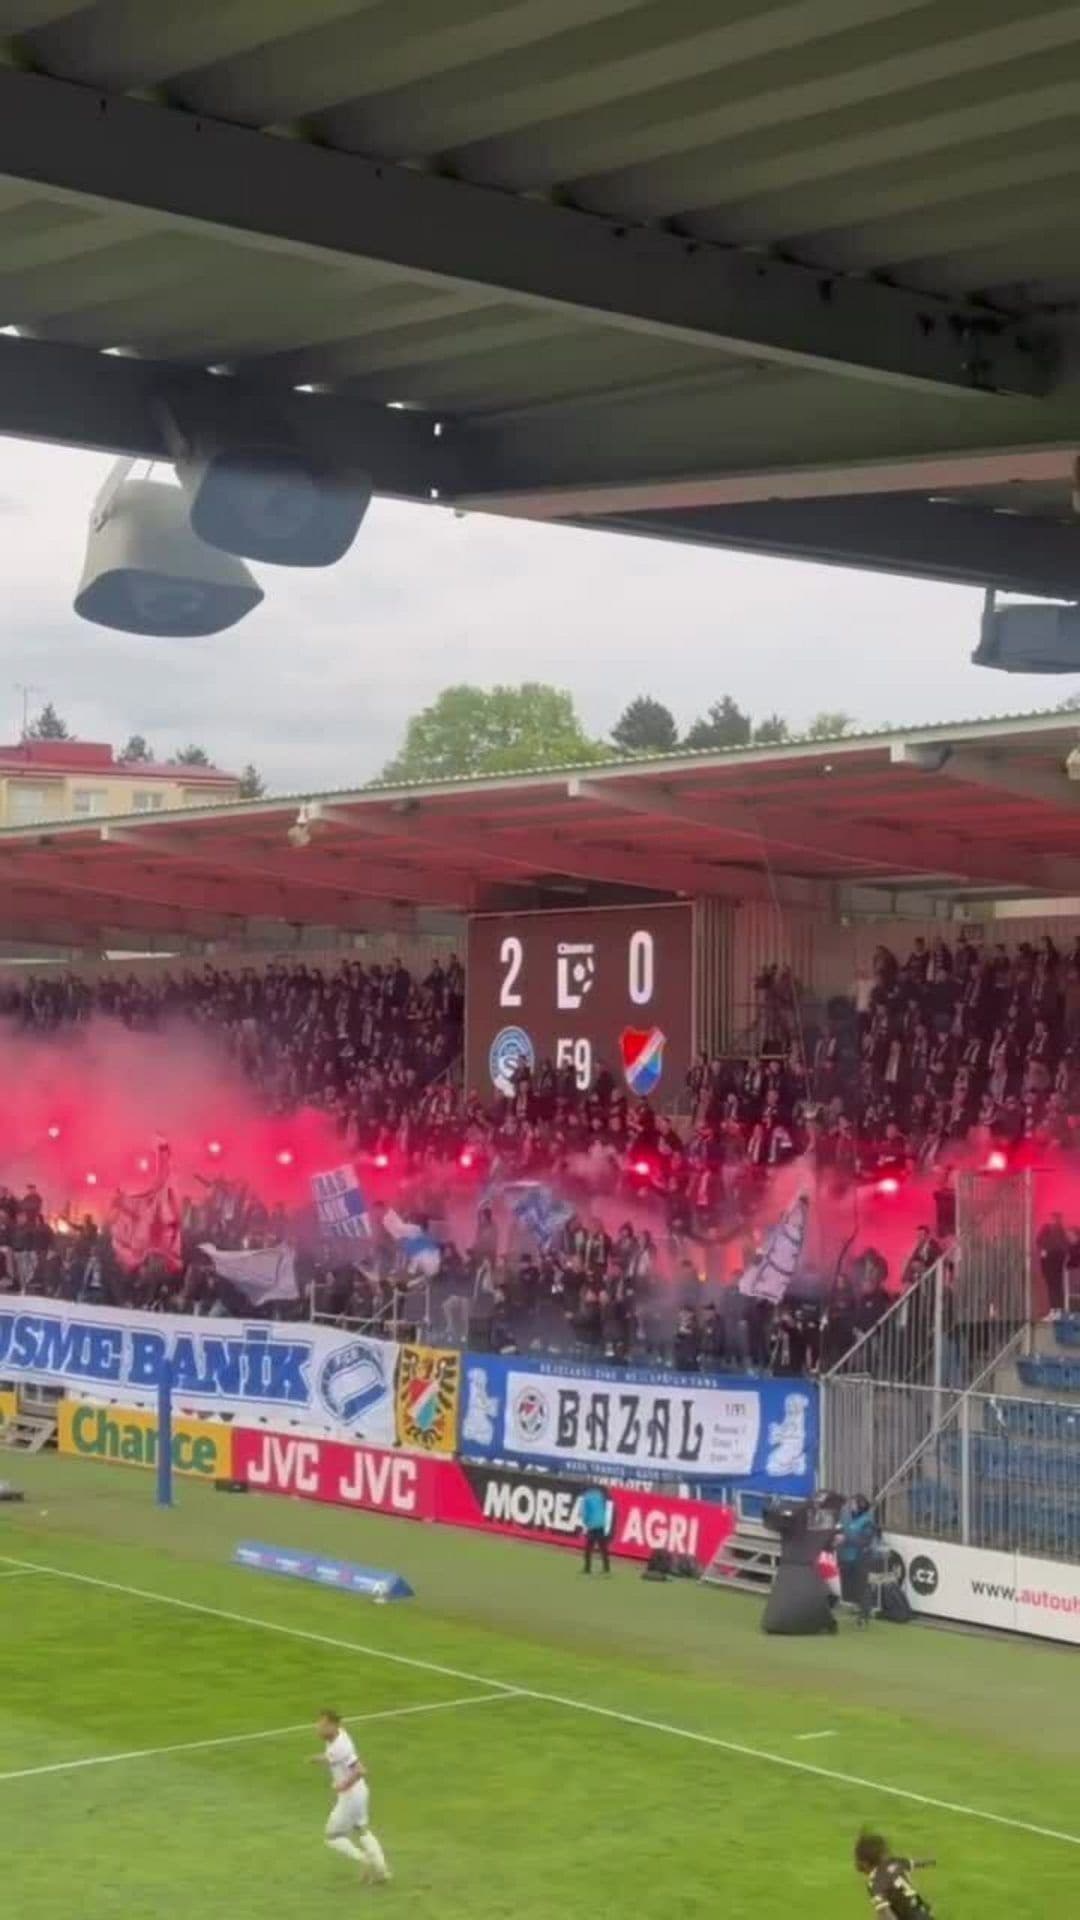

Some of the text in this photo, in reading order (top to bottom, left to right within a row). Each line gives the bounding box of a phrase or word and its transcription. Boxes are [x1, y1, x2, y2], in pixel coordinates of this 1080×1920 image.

[500, 930, 654, 1007] 2 0
[130, 1328, 311, 1402] BANÍK
[556, 1389, 703, 1461] BAZAL
[247, 1436, 418, 1510] JVC JVC
[621, 1509, 700, 1557] AGRI
